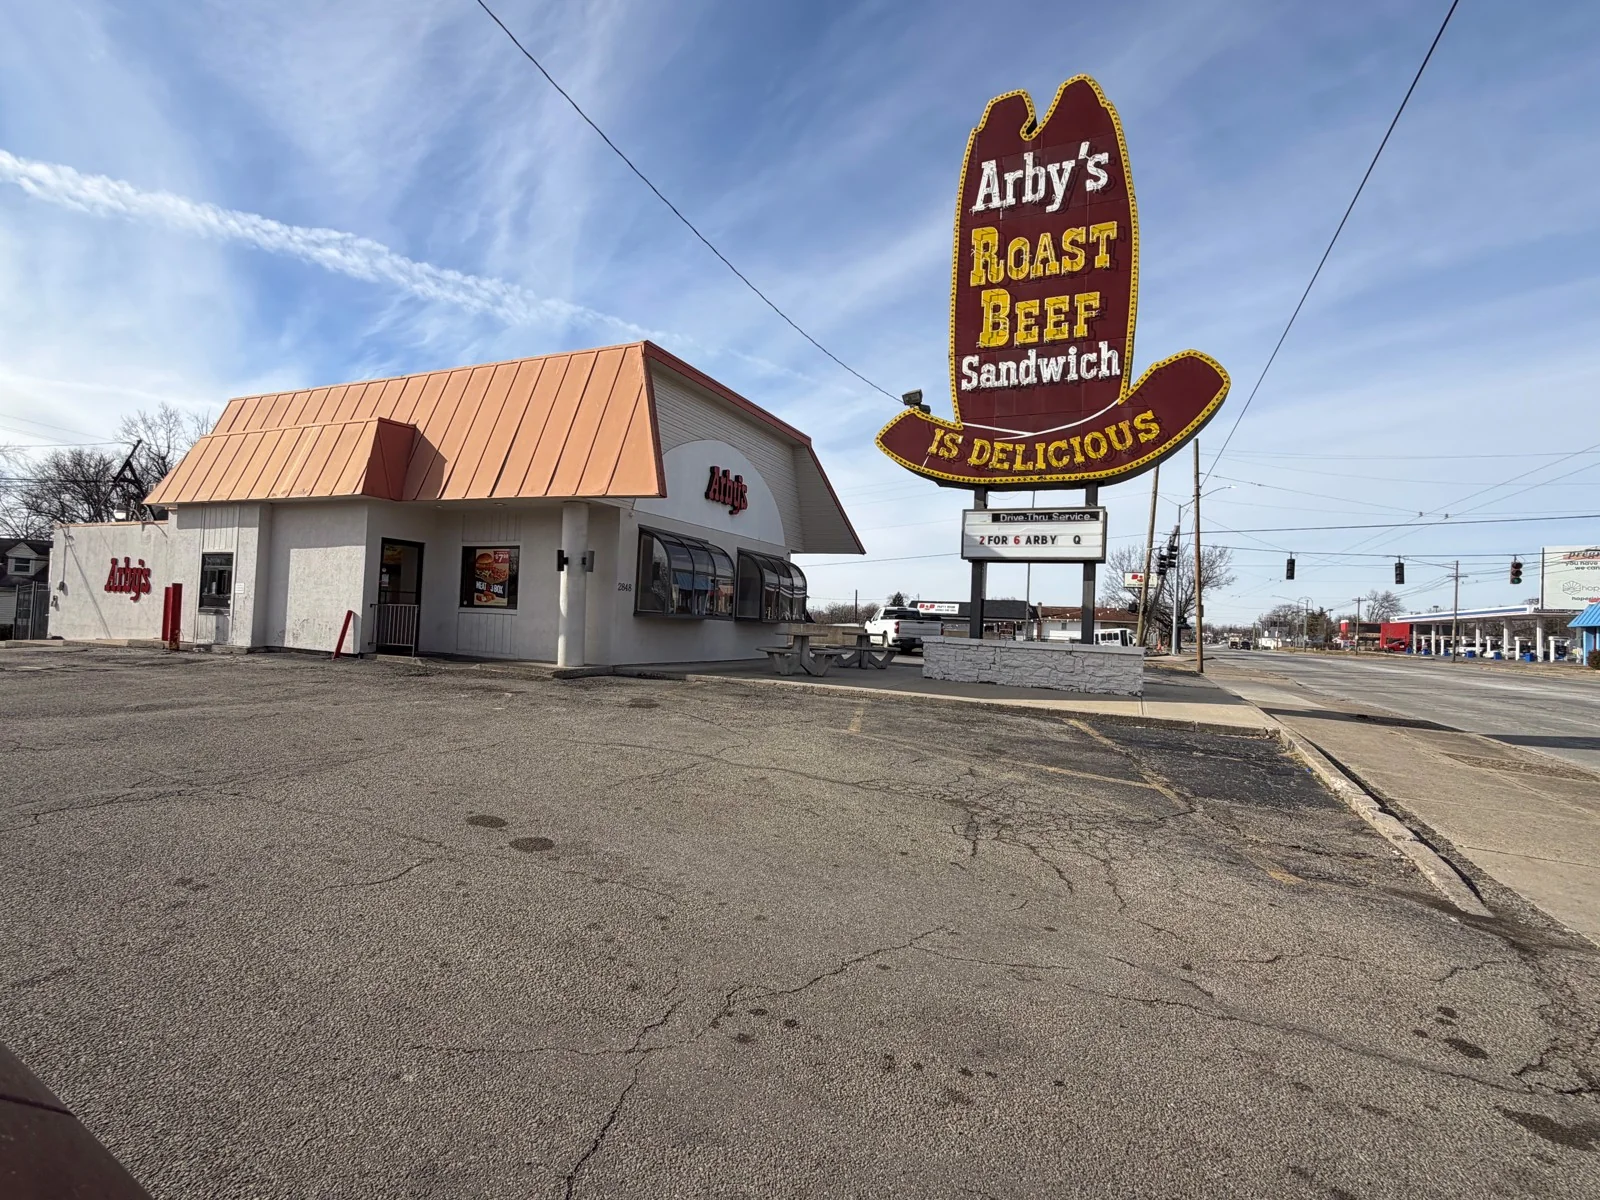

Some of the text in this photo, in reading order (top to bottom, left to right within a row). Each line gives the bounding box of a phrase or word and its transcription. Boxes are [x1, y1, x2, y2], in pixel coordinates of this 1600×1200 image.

[969, 141, 1110, 214] Arby's
[961, 341, 1121, 390] Sandwich
[928, 410, 1161, 472] IS DELICIOUS
[705, 466, 748, 515] Arby's
[979, 535, 1082, 545] 2 FOR 6 ARBY Q
[104, 556, 152, 601] Arby's
